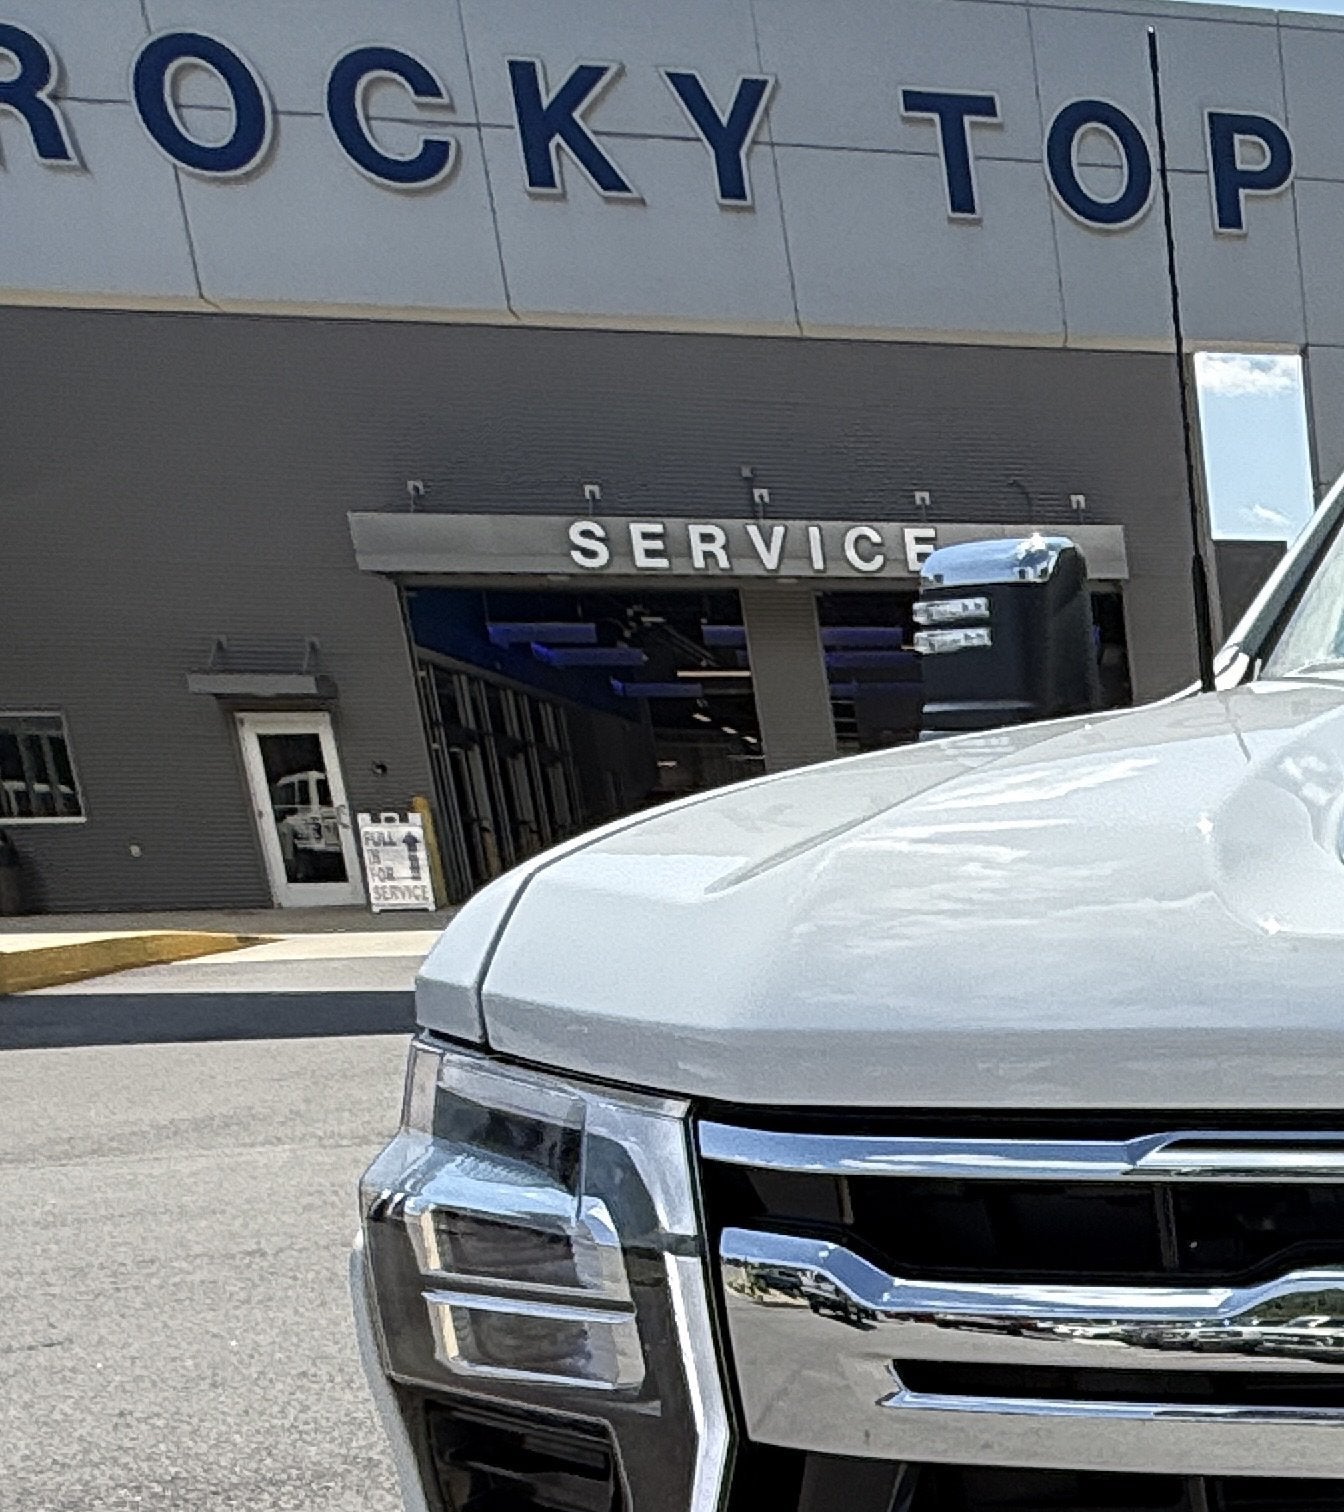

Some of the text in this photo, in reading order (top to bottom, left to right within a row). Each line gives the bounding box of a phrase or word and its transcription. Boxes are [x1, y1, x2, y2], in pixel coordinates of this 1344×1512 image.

[0, 20, 1295, 236] ROCKY TOP
[568, 520, 936, 572] SERVICE
[372, 884, 430, 901] SERVICE
